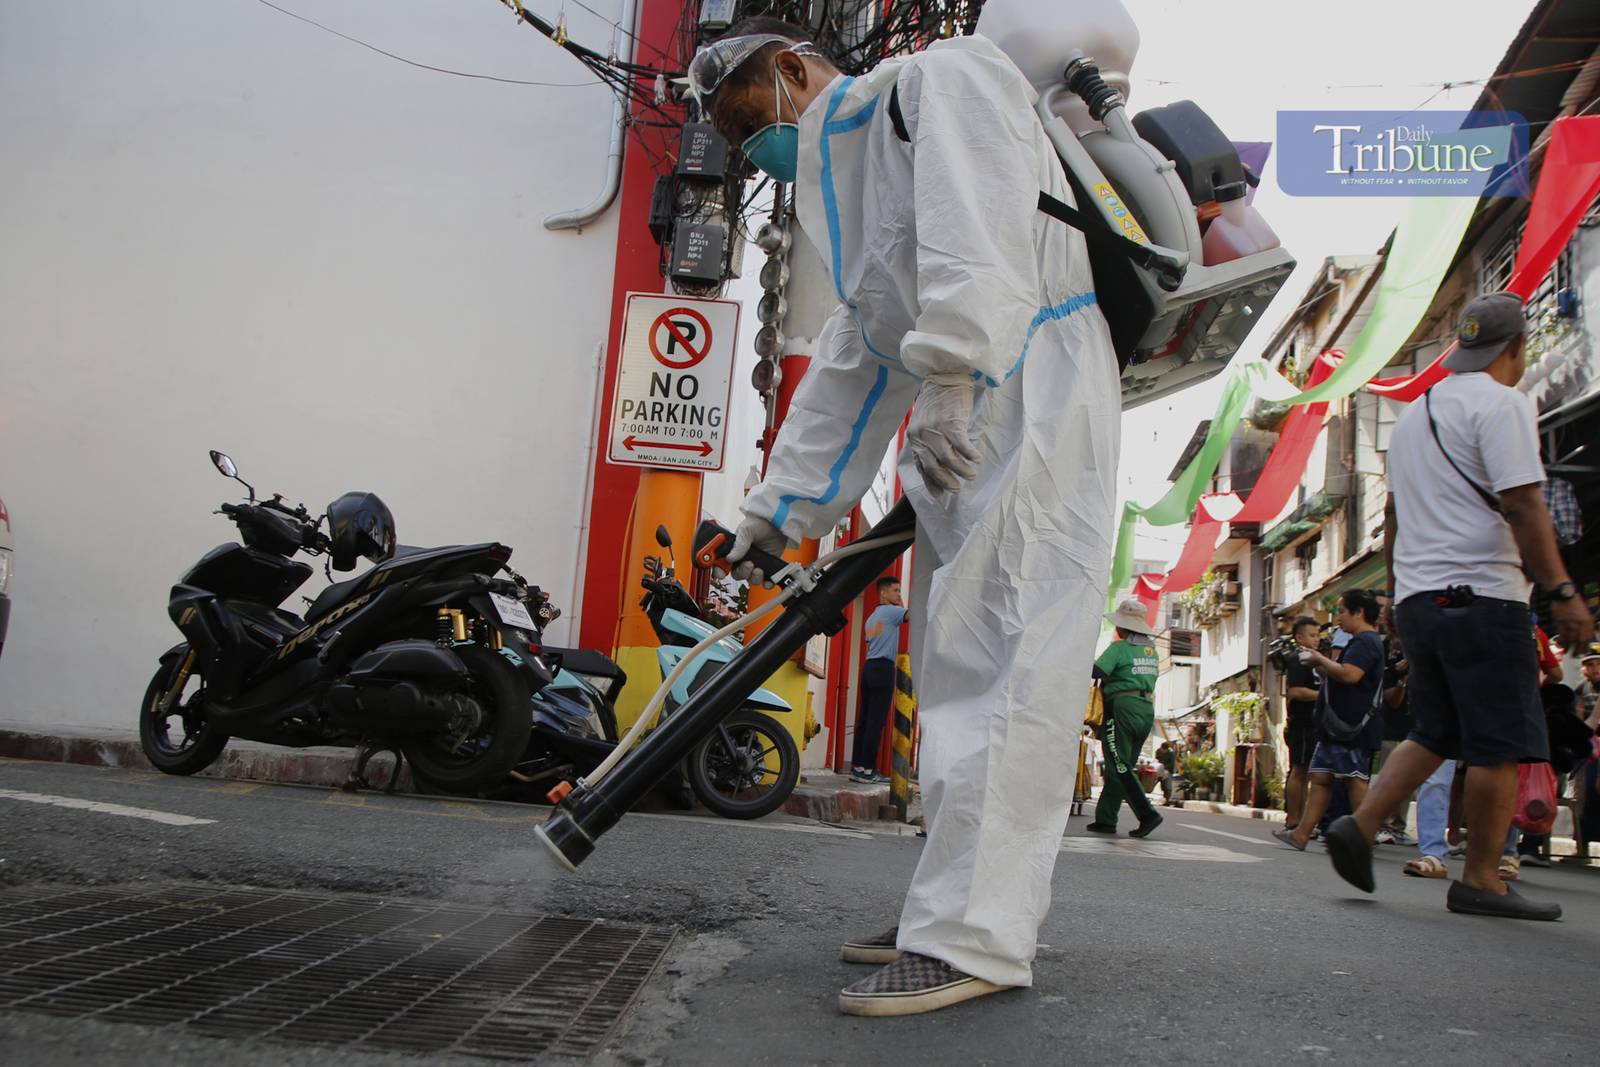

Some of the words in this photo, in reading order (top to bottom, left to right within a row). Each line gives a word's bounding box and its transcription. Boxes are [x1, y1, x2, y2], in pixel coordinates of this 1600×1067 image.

[649, 371, 699, 401] NO
[621, 399, 721, 427] PARKING
[645, 425, 659, 435] AM
[663, 426, 676, 437] TO
[680, 427, 703, 439] 7:00
[637, 454, 658, 462] MMDA
[697, 460, 713, 468] CITY
